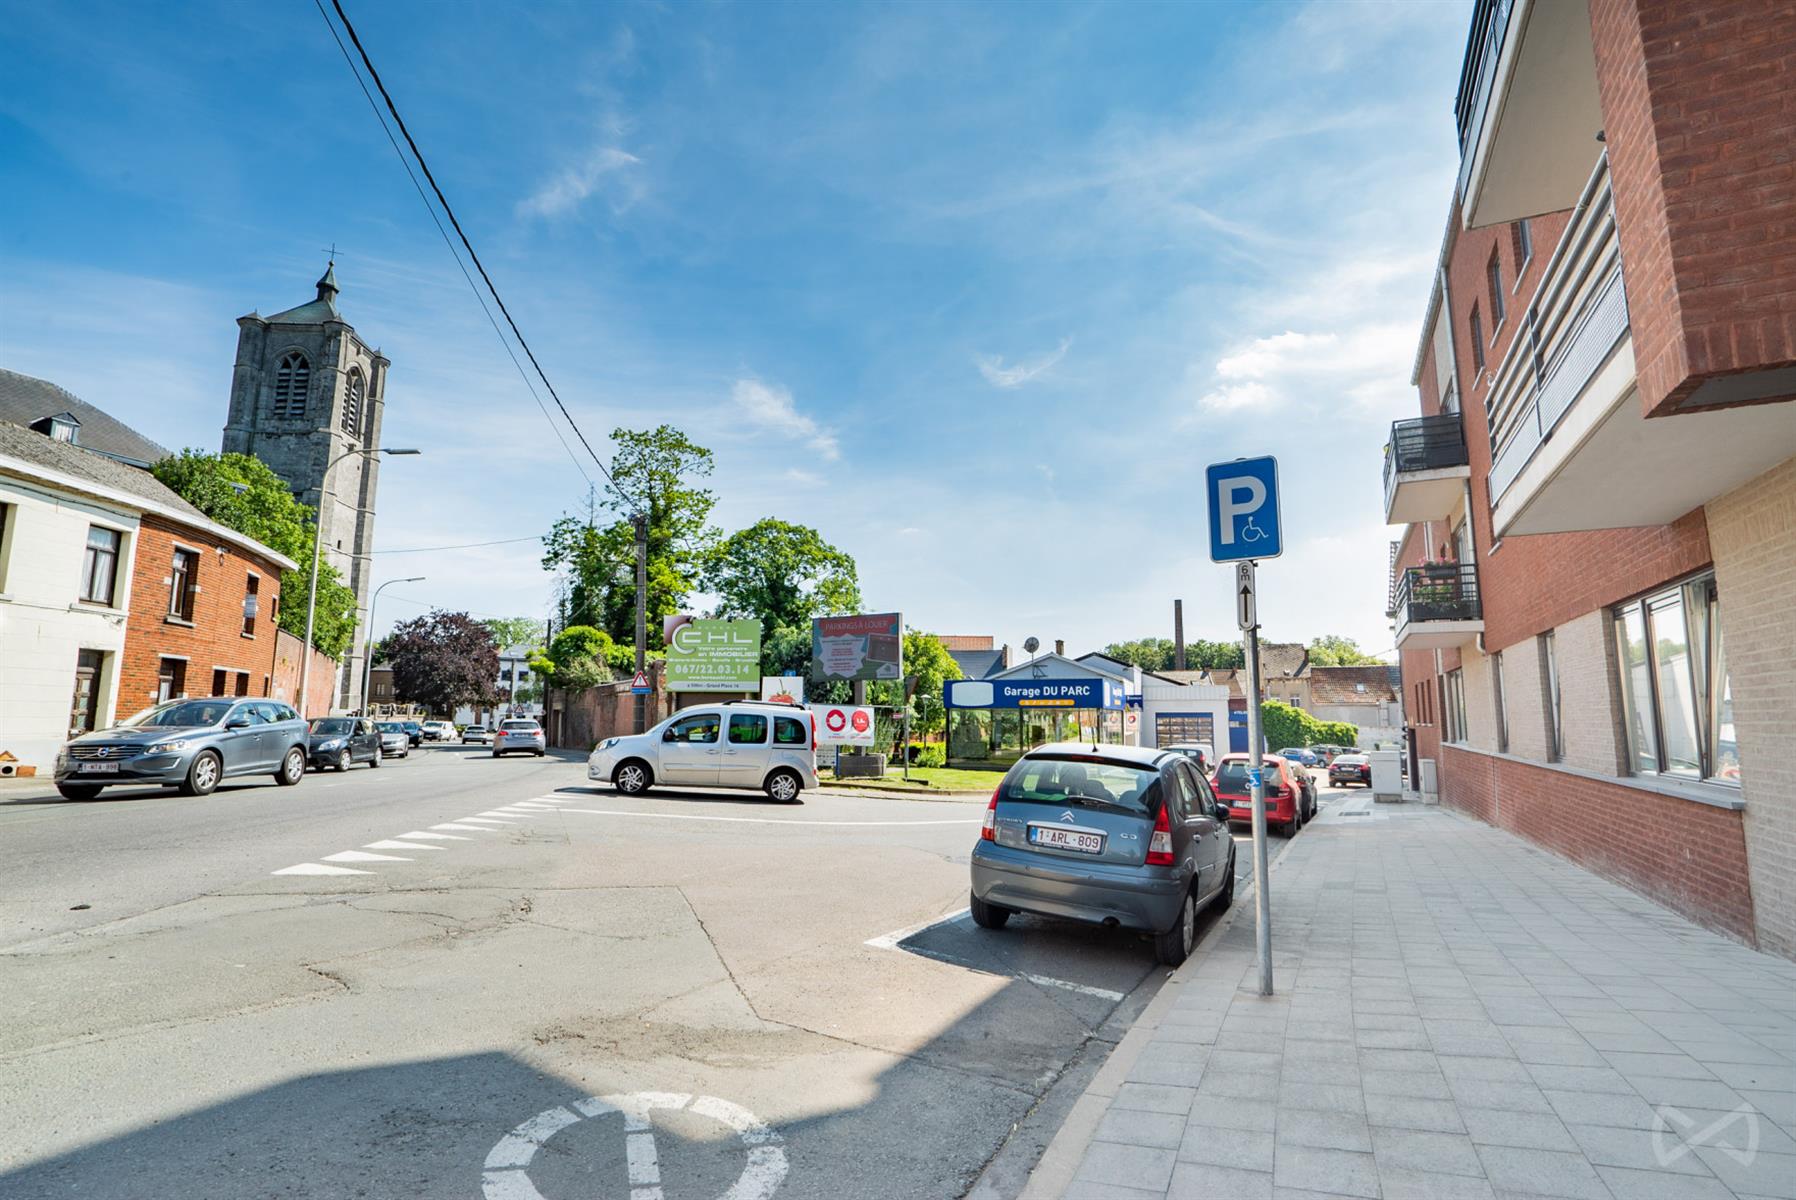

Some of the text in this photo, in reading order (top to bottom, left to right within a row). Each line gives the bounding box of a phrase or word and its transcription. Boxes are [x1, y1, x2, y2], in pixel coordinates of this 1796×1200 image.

[1218, 475, 1267, 545] P
[675, 664, 750, 675] 067/22.03.14
[1004, 685, 1091, 698] Garage DU PARC
